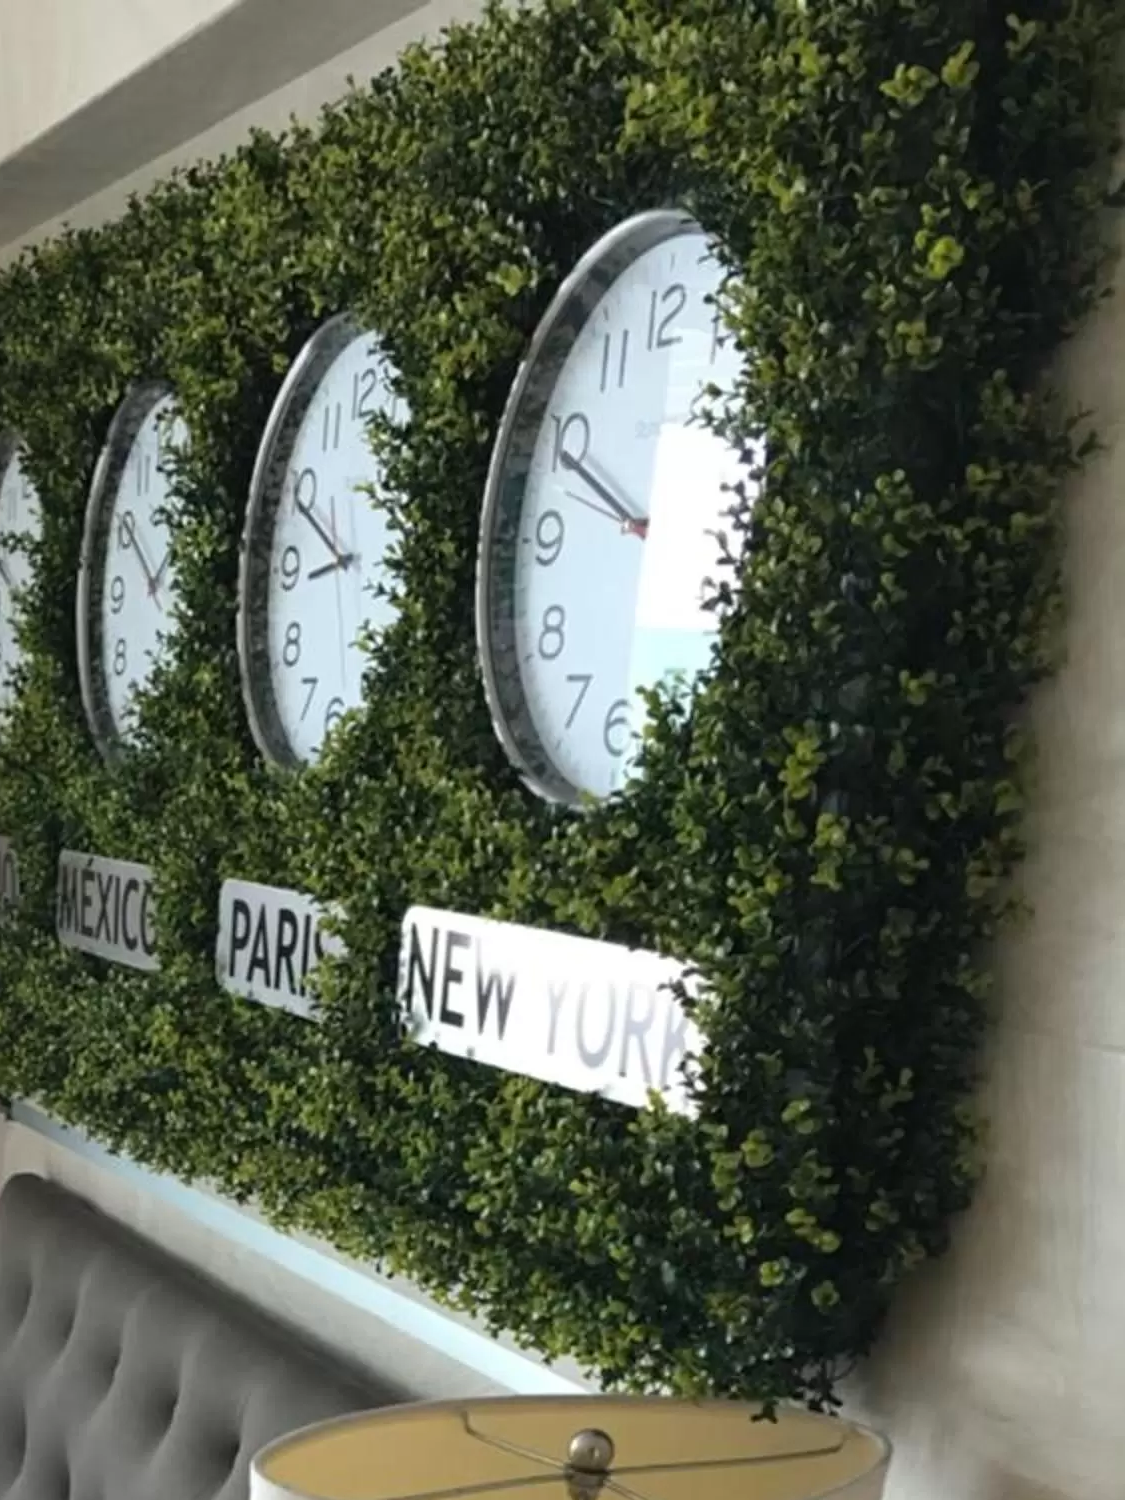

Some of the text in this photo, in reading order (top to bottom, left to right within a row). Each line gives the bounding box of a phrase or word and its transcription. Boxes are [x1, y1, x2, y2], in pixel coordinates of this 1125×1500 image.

[647, 283, 687, 352] 12
[600, 328, 629, 393] 11
[351, 368, 377, 421] 12
[322, 401, 342, 453] 11
[551, 412, 591, 473] 10
[136, 455, 151, 497] 11
[535, 509, 565, 567] 9
[110, 575, 125, 615] 9
[281, 546, 301, 591] 9
[113, 638, 127, 676] 8
[283, 621, 302, 667] 8
[538, 604, 566, 661] 8
[300, 678, 319, 722] 7
[565, 674, 594, 729] 7
[603, 698, 633, 758] 6
[58, 857, 156, 957] MÉXICO
[229, 898, 324, 998] PARI
[406, 921, 689, 1091] NEW YORK
